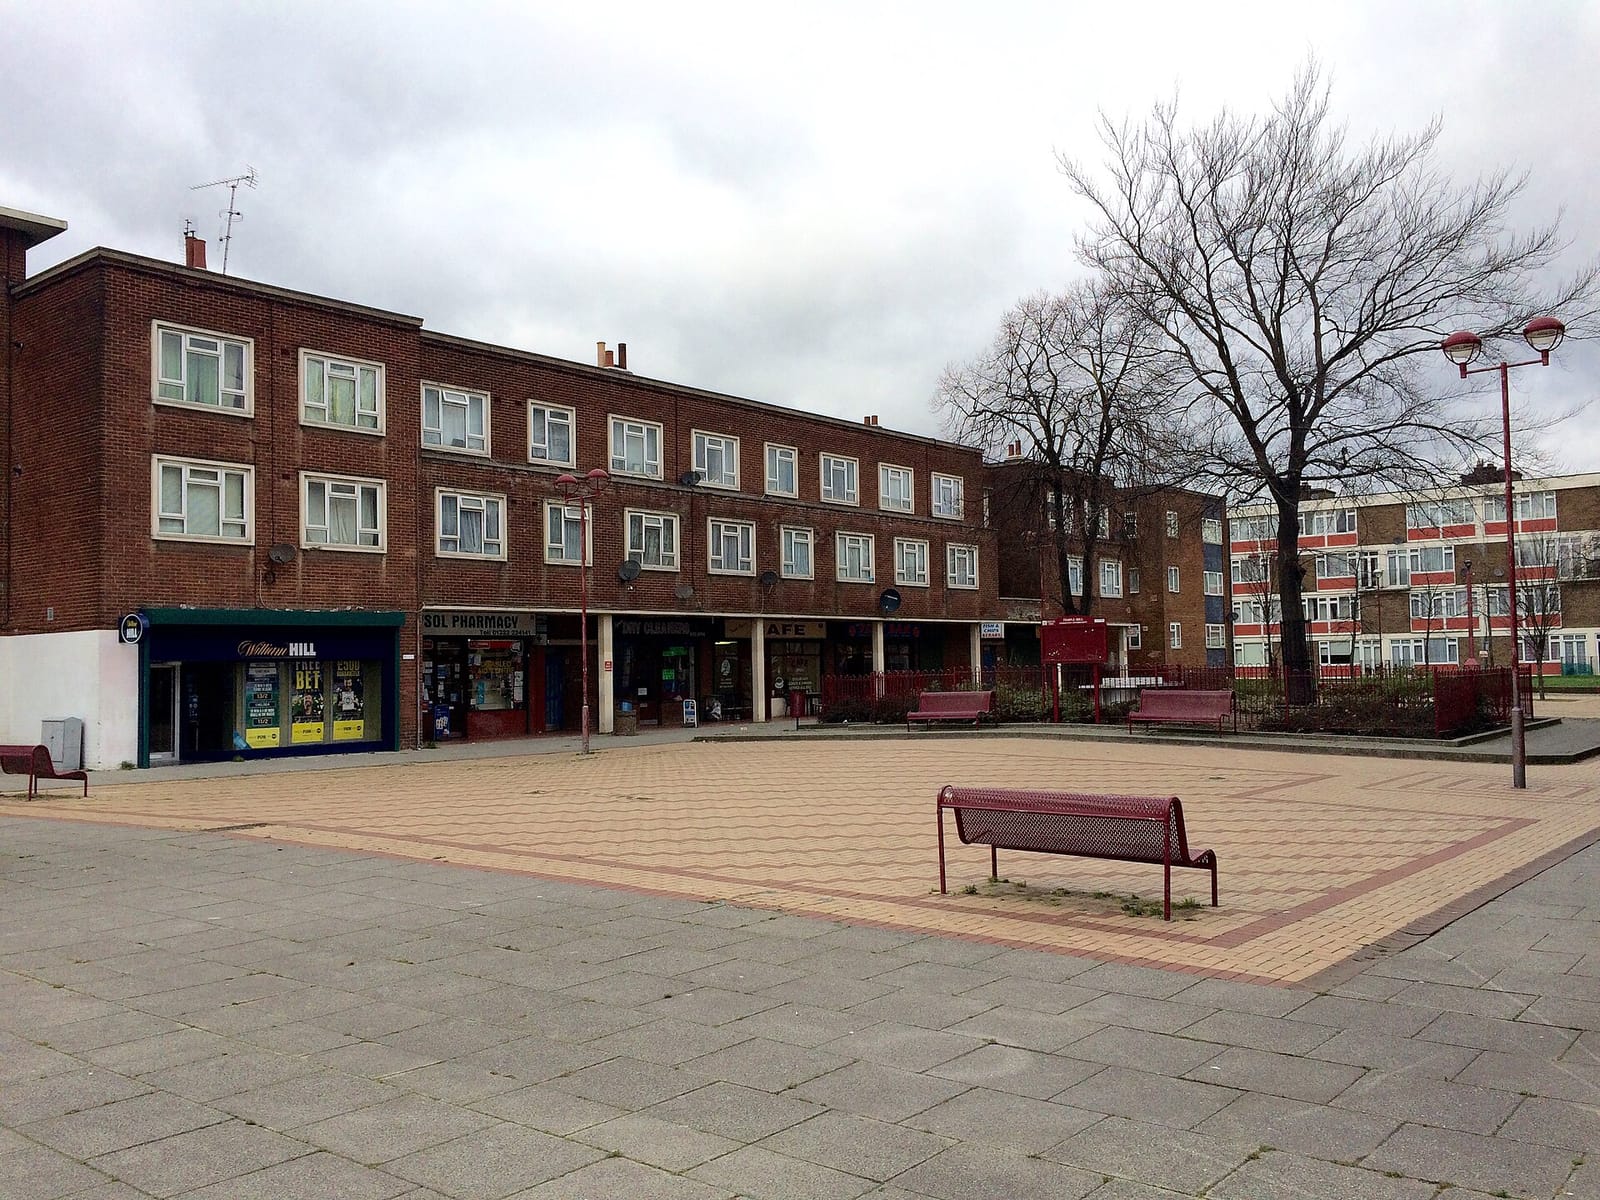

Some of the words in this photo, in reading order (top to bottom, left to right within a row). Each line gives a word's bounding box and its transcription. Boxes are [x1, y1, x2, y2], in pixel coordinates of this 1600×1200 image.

[424, 614, 448, 628] SOL
[452, 614, 518, 629] PHARMACY
[766, 622, 806, 636] AFE
[237, 640, 289, 657] William
[289, 641, 317, 657] HILL
[295, 670, 321, 690] BET
